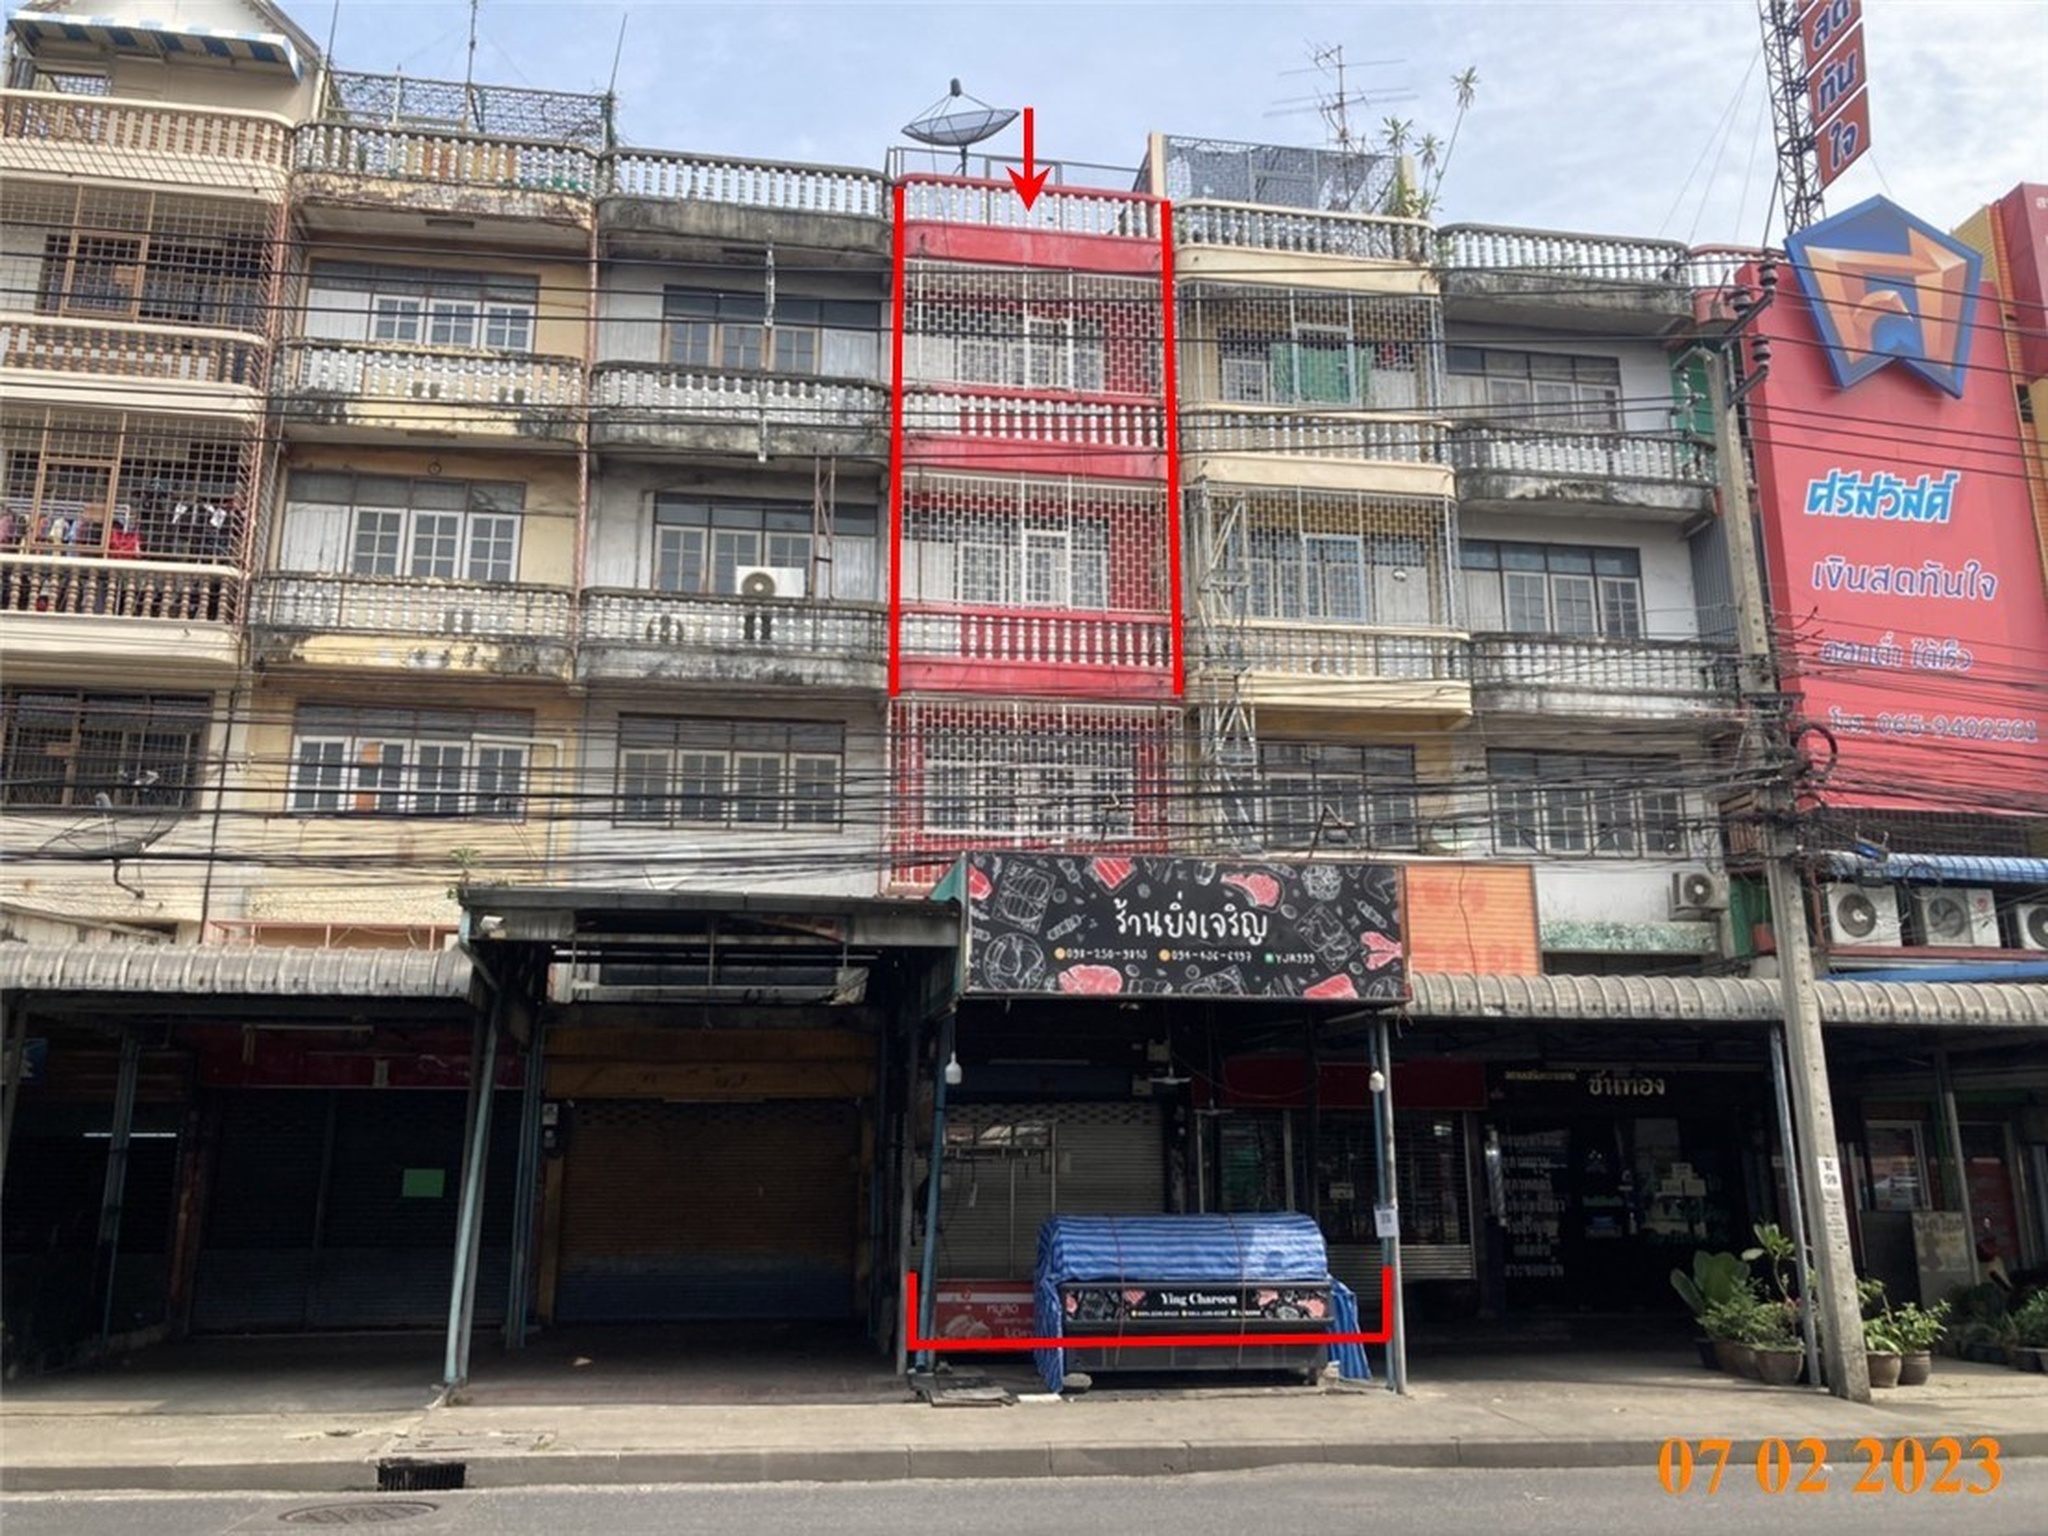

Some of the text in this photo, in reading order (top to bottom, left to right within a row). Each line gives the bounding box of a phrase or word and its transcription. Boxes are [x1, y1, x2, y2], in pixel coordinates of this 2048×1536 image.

[1817, 48, 1857, 114] ทัน
[1830, 118, 1858, 172] ใจ
[1805, 466, 1960, 525] ศรีสวัสดิ์
[1812, 555, 1998, 601] เงินสดทันใจ
[1113, 890, 1268, 946] ร้านยิ่งเจริญ
[1160, 1292, 1187, 1306] Ying
